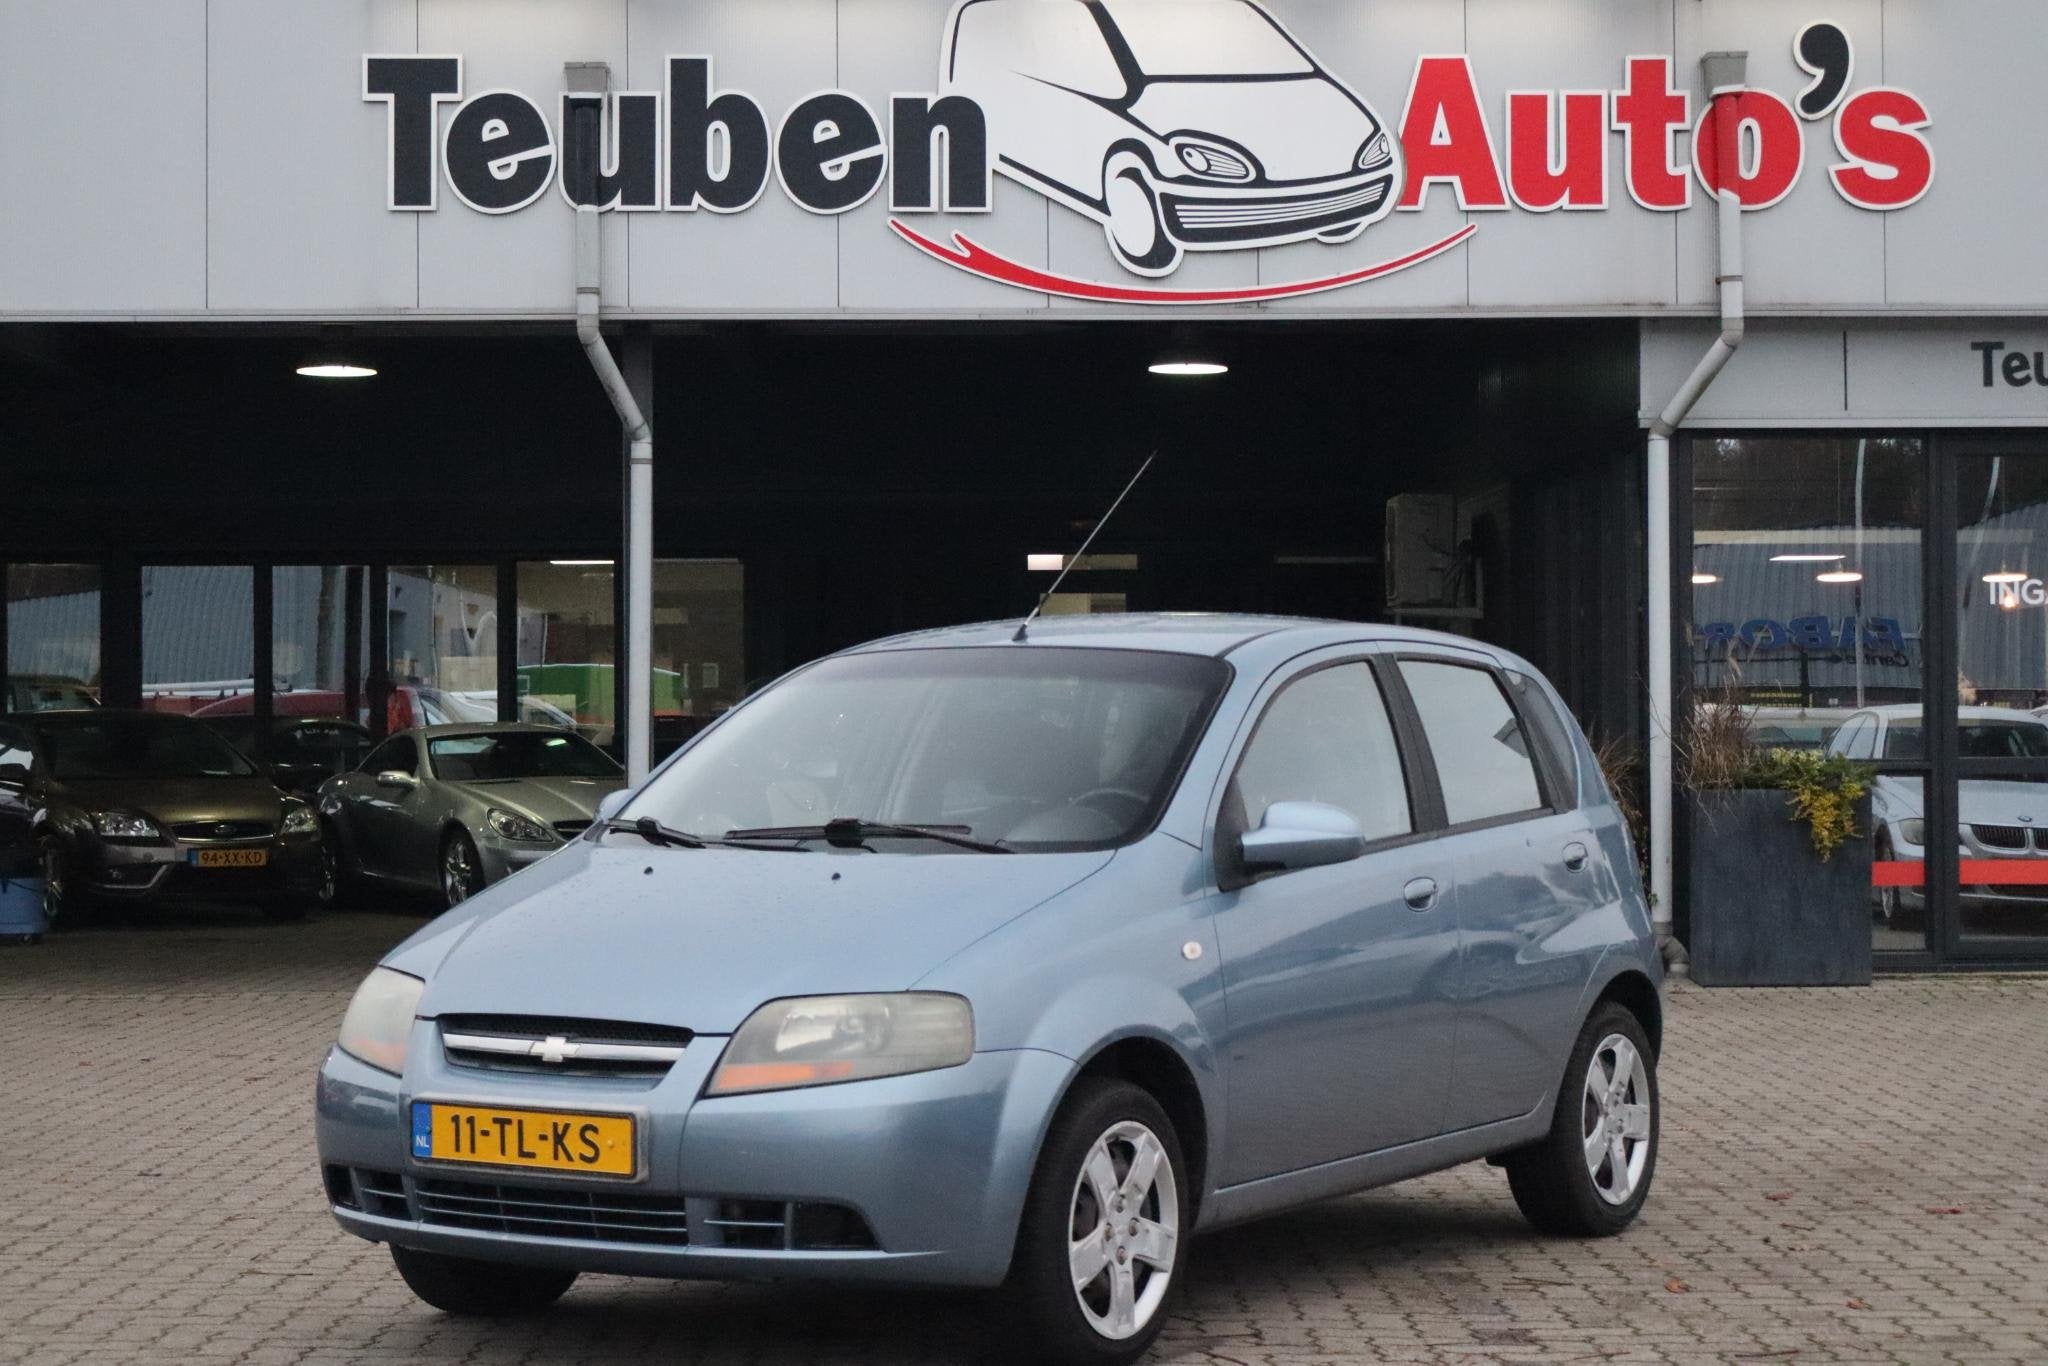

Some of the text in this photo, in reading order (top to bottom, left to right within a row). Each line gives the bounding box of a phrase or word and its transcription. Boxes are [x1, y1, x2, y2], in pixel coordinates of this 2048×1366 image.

[364, 23, 1934, 212] Teuben Auto's
[1989, 578, 2048, 605] ING
[415, 1134, 430, 1148] NL
[451, 1114, 600, 1164] 11-TL-KS
